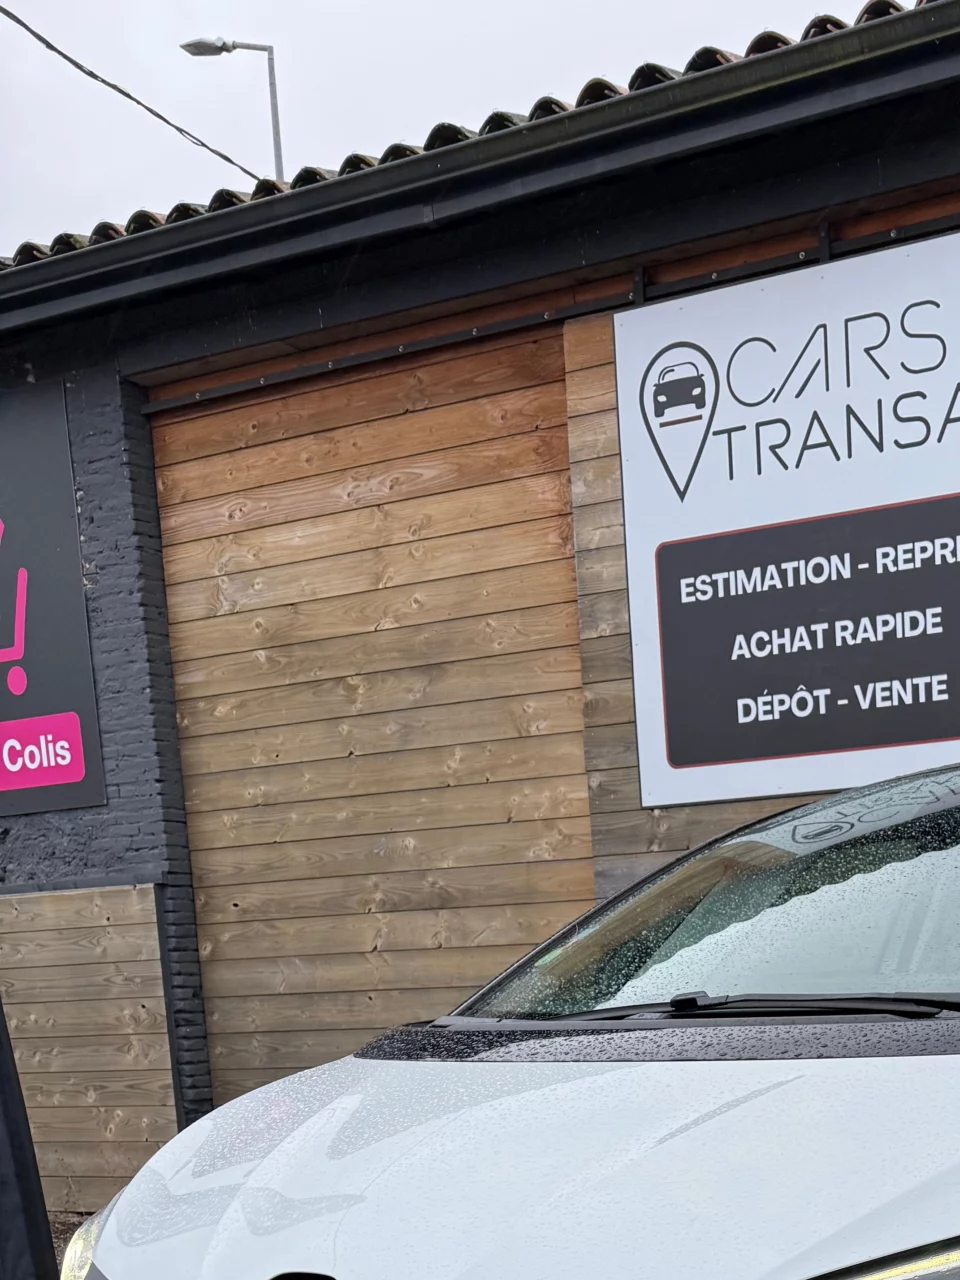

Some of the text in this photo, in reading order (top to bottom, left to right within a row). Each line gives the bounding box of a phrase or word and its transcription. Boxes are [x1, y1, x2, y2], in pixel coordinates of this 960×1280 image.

[727, 300, 946, 408] CARS
[681, 553, 851, 604] ESTIMATION
[731, 607, 943, 661] ACHAT RAPIDE
[737, 684, 831, 724] DÉPÔT
[854, 674, 949, 710] VENTE
[3, 734, 72, 772] Colis
